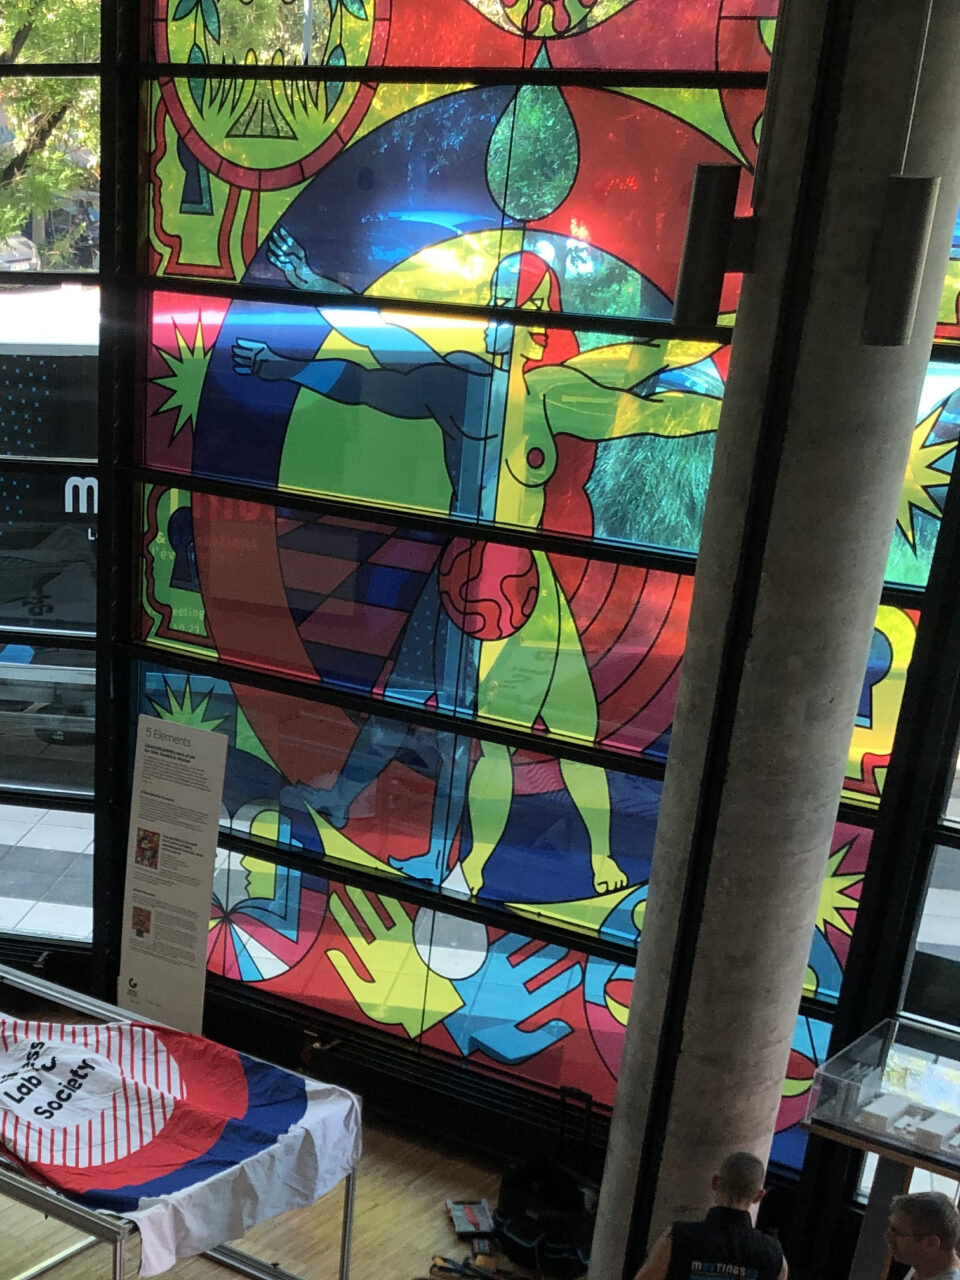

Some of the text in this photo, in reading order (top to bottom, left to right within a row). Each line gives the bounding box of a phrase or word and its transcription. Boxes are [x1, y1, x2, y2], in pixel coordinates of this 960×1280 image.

[145, 727, 192, 748] 5 Elements
[3, 1075, 43, 1104] Lab
[34, 1058, 96, 1119] Society
